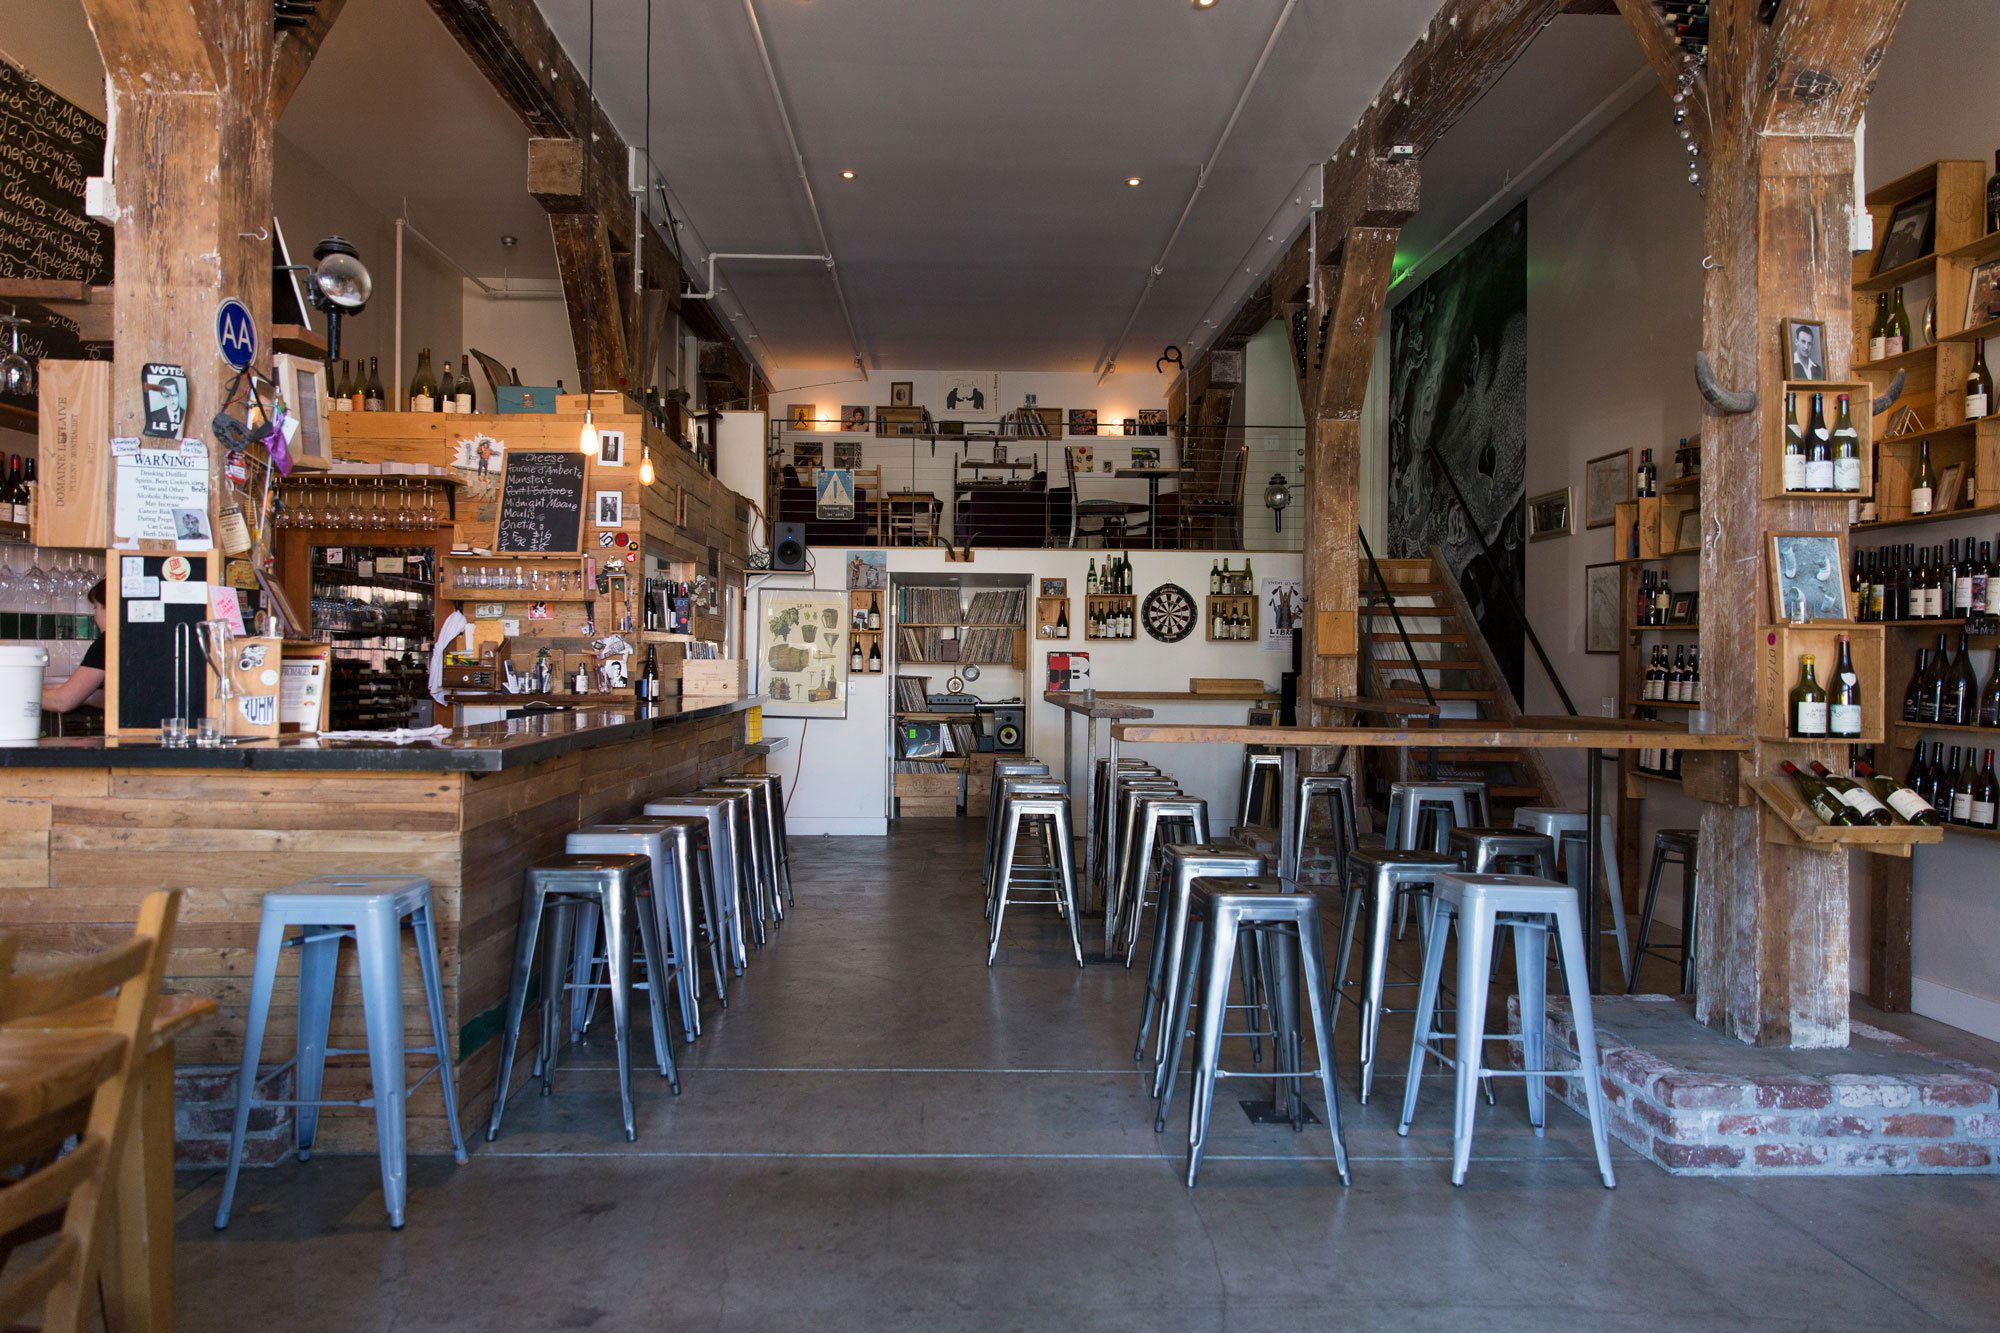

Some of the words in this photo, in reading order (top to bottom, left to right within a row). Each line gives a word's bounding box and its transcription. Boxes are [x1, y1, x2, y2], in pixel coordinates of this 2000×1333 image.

[53, 207, 103, 245] Umbria
[30, 241, 84, 280] Applegate
[222, 312, 253, 352] AA
[149, 365, 185, 377] VOTEZ
[57, 397, 67, 451] LEFLAIVE
[152, 421, 168, 432] LE
[134, 454, 195, 468] WARNING:
[56, 454, 66, 507] DOMAINE
[507, 474, 545, 485] Munster
[504, 497, 545, 512] Midnight
[504, 509, 535, 519] Moulis
[500, 519, 536, 531] Onetik
